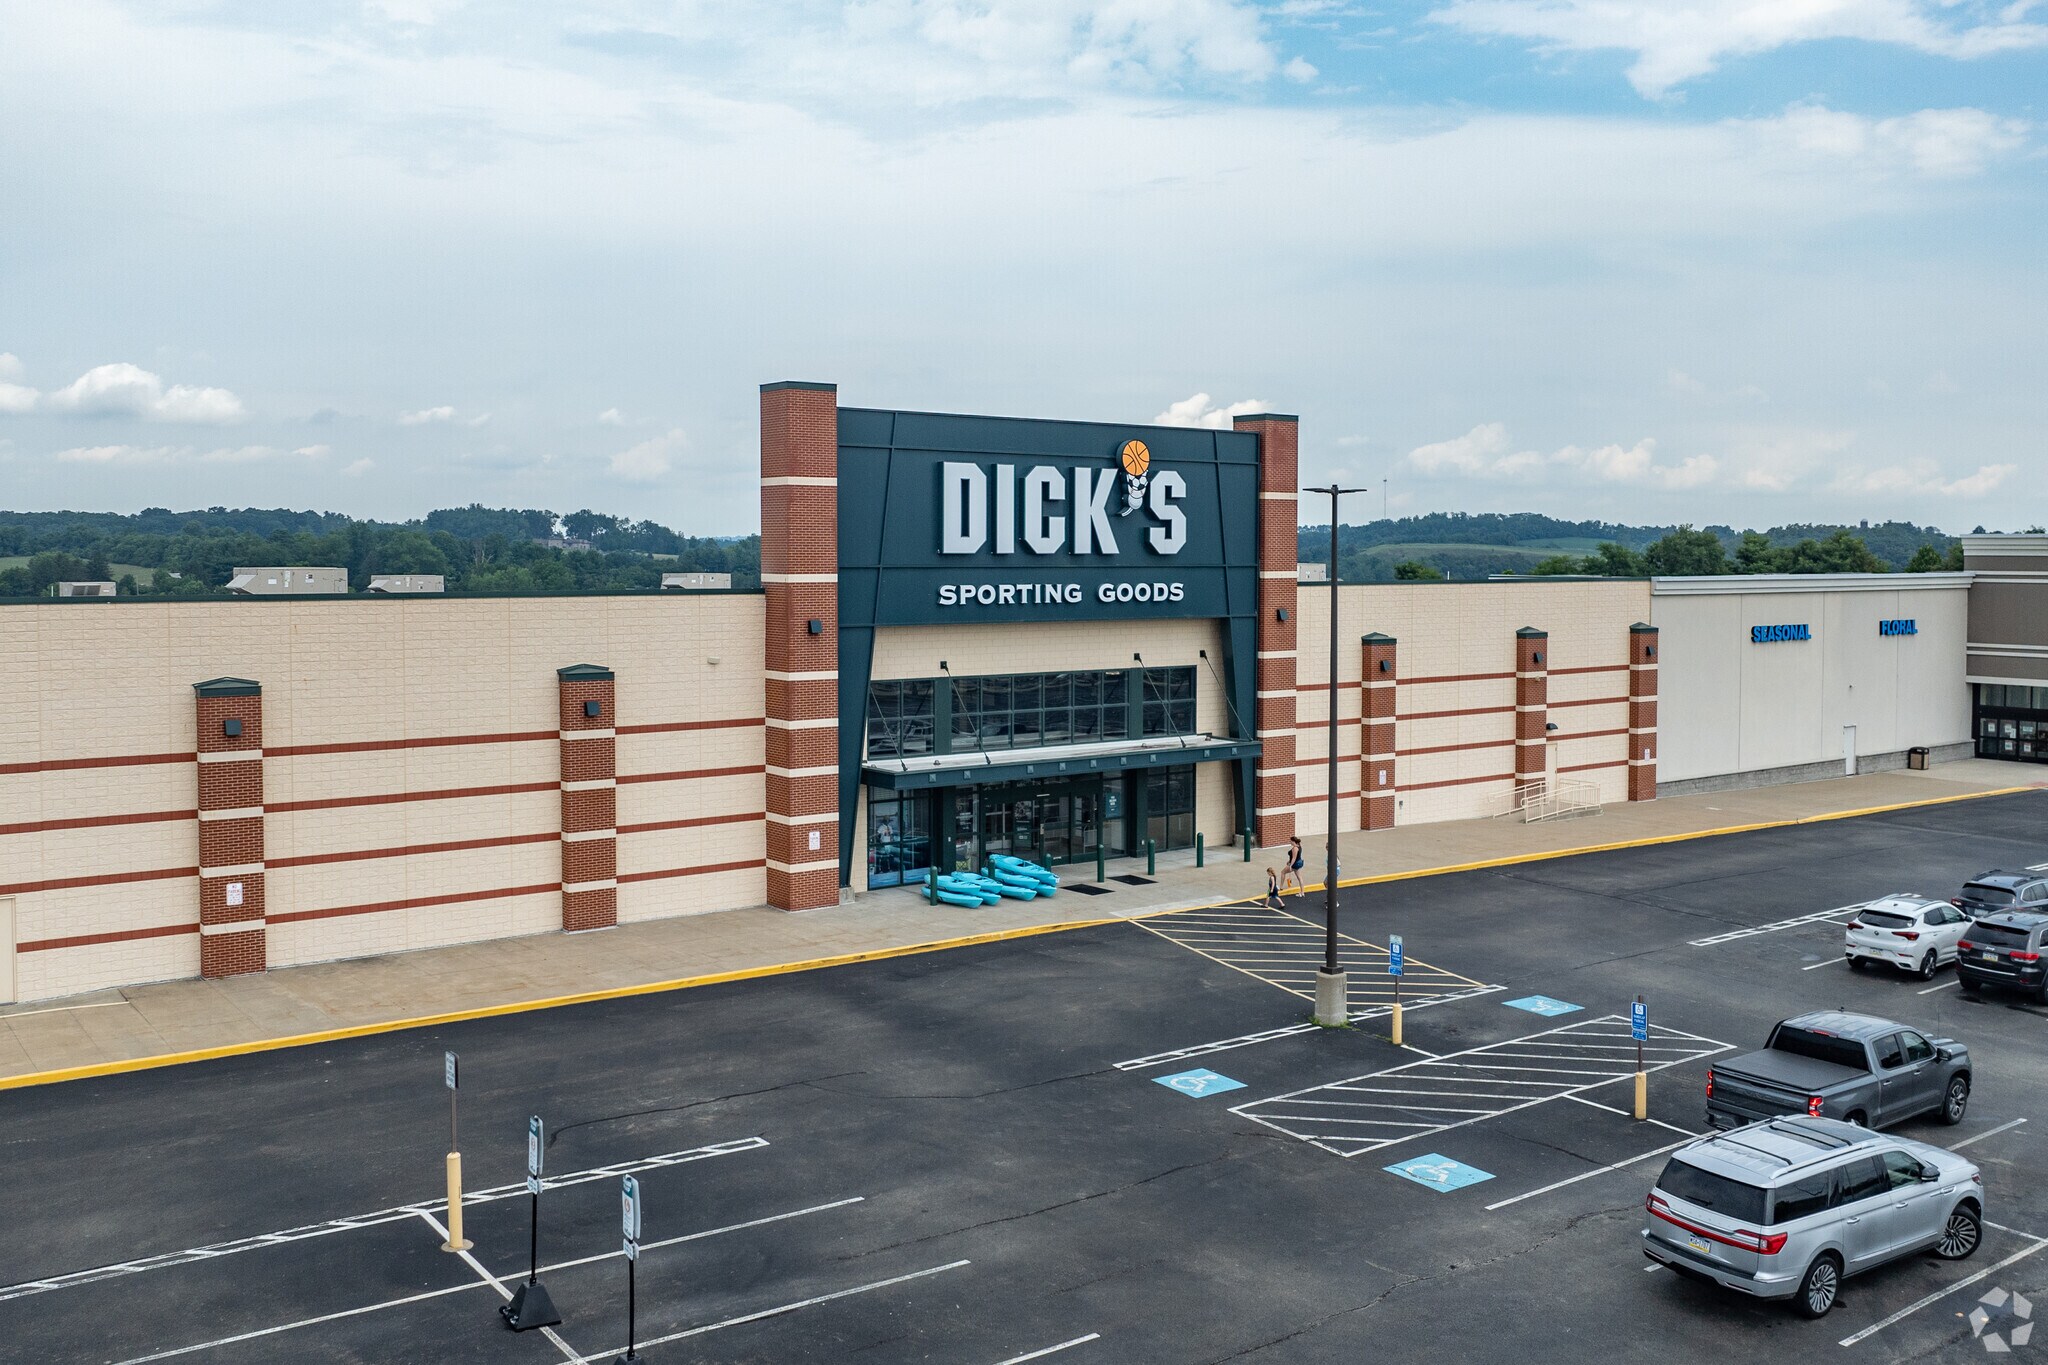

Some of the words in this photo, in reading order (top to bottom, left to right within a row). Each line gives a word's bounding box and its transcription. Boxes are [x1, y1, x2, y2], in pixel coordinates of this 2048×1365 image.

[941, 439, 1187, 555] DICK'S
[938, 583, 1083, 605] SPORTING
[1098, 582, 1185, 602] GOODS
[1752, 624, 1811, 642] SEASONAL
[1880, 619, 1918, 635] FLORAL
